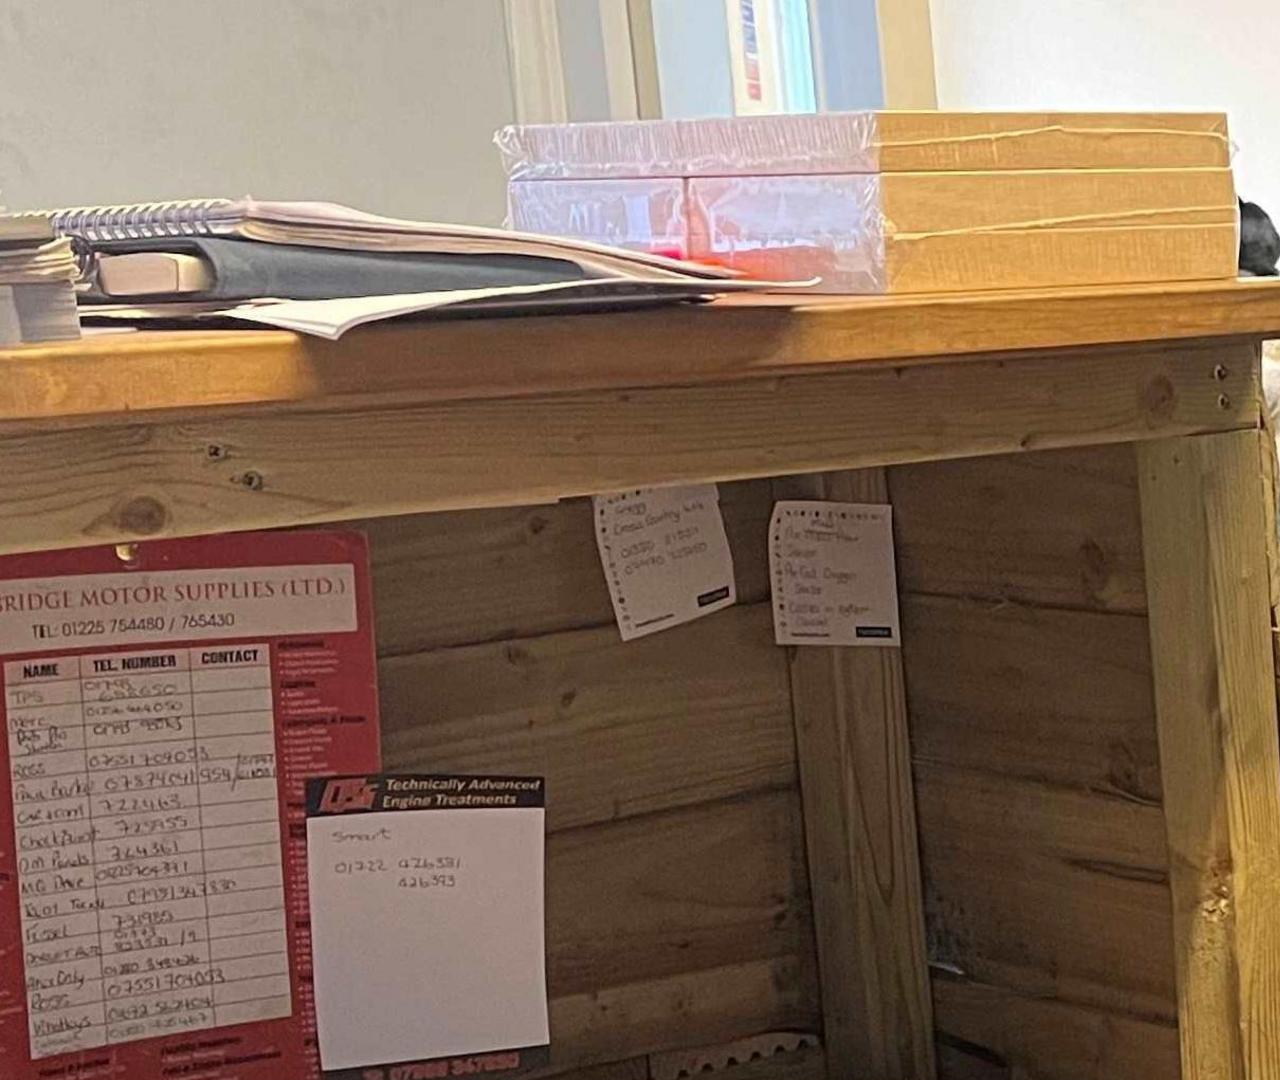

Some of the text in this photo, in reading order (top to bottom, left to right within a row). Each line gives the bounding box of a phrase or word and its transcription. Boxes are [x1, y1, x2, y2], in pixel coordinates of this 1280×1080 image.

[79, 586, 167, 608] MOTOR
[174, 578, 275, 600] SUPPLIES
[281, 577, 346, 598] (LTD.)
[61, 620, 105, 637] 01225
[110, 616, 165, 633] 754480
[181, 612, 236, 630] 765430
[122, 654, 177, 670] NUMBER
[201, 649, 259, 665] CONTACT
[23, 664, 60, 678] NAME
[386, 778, 541, 794] Technically Advanced
[383, 794, 517, 811] Engine Treatments
